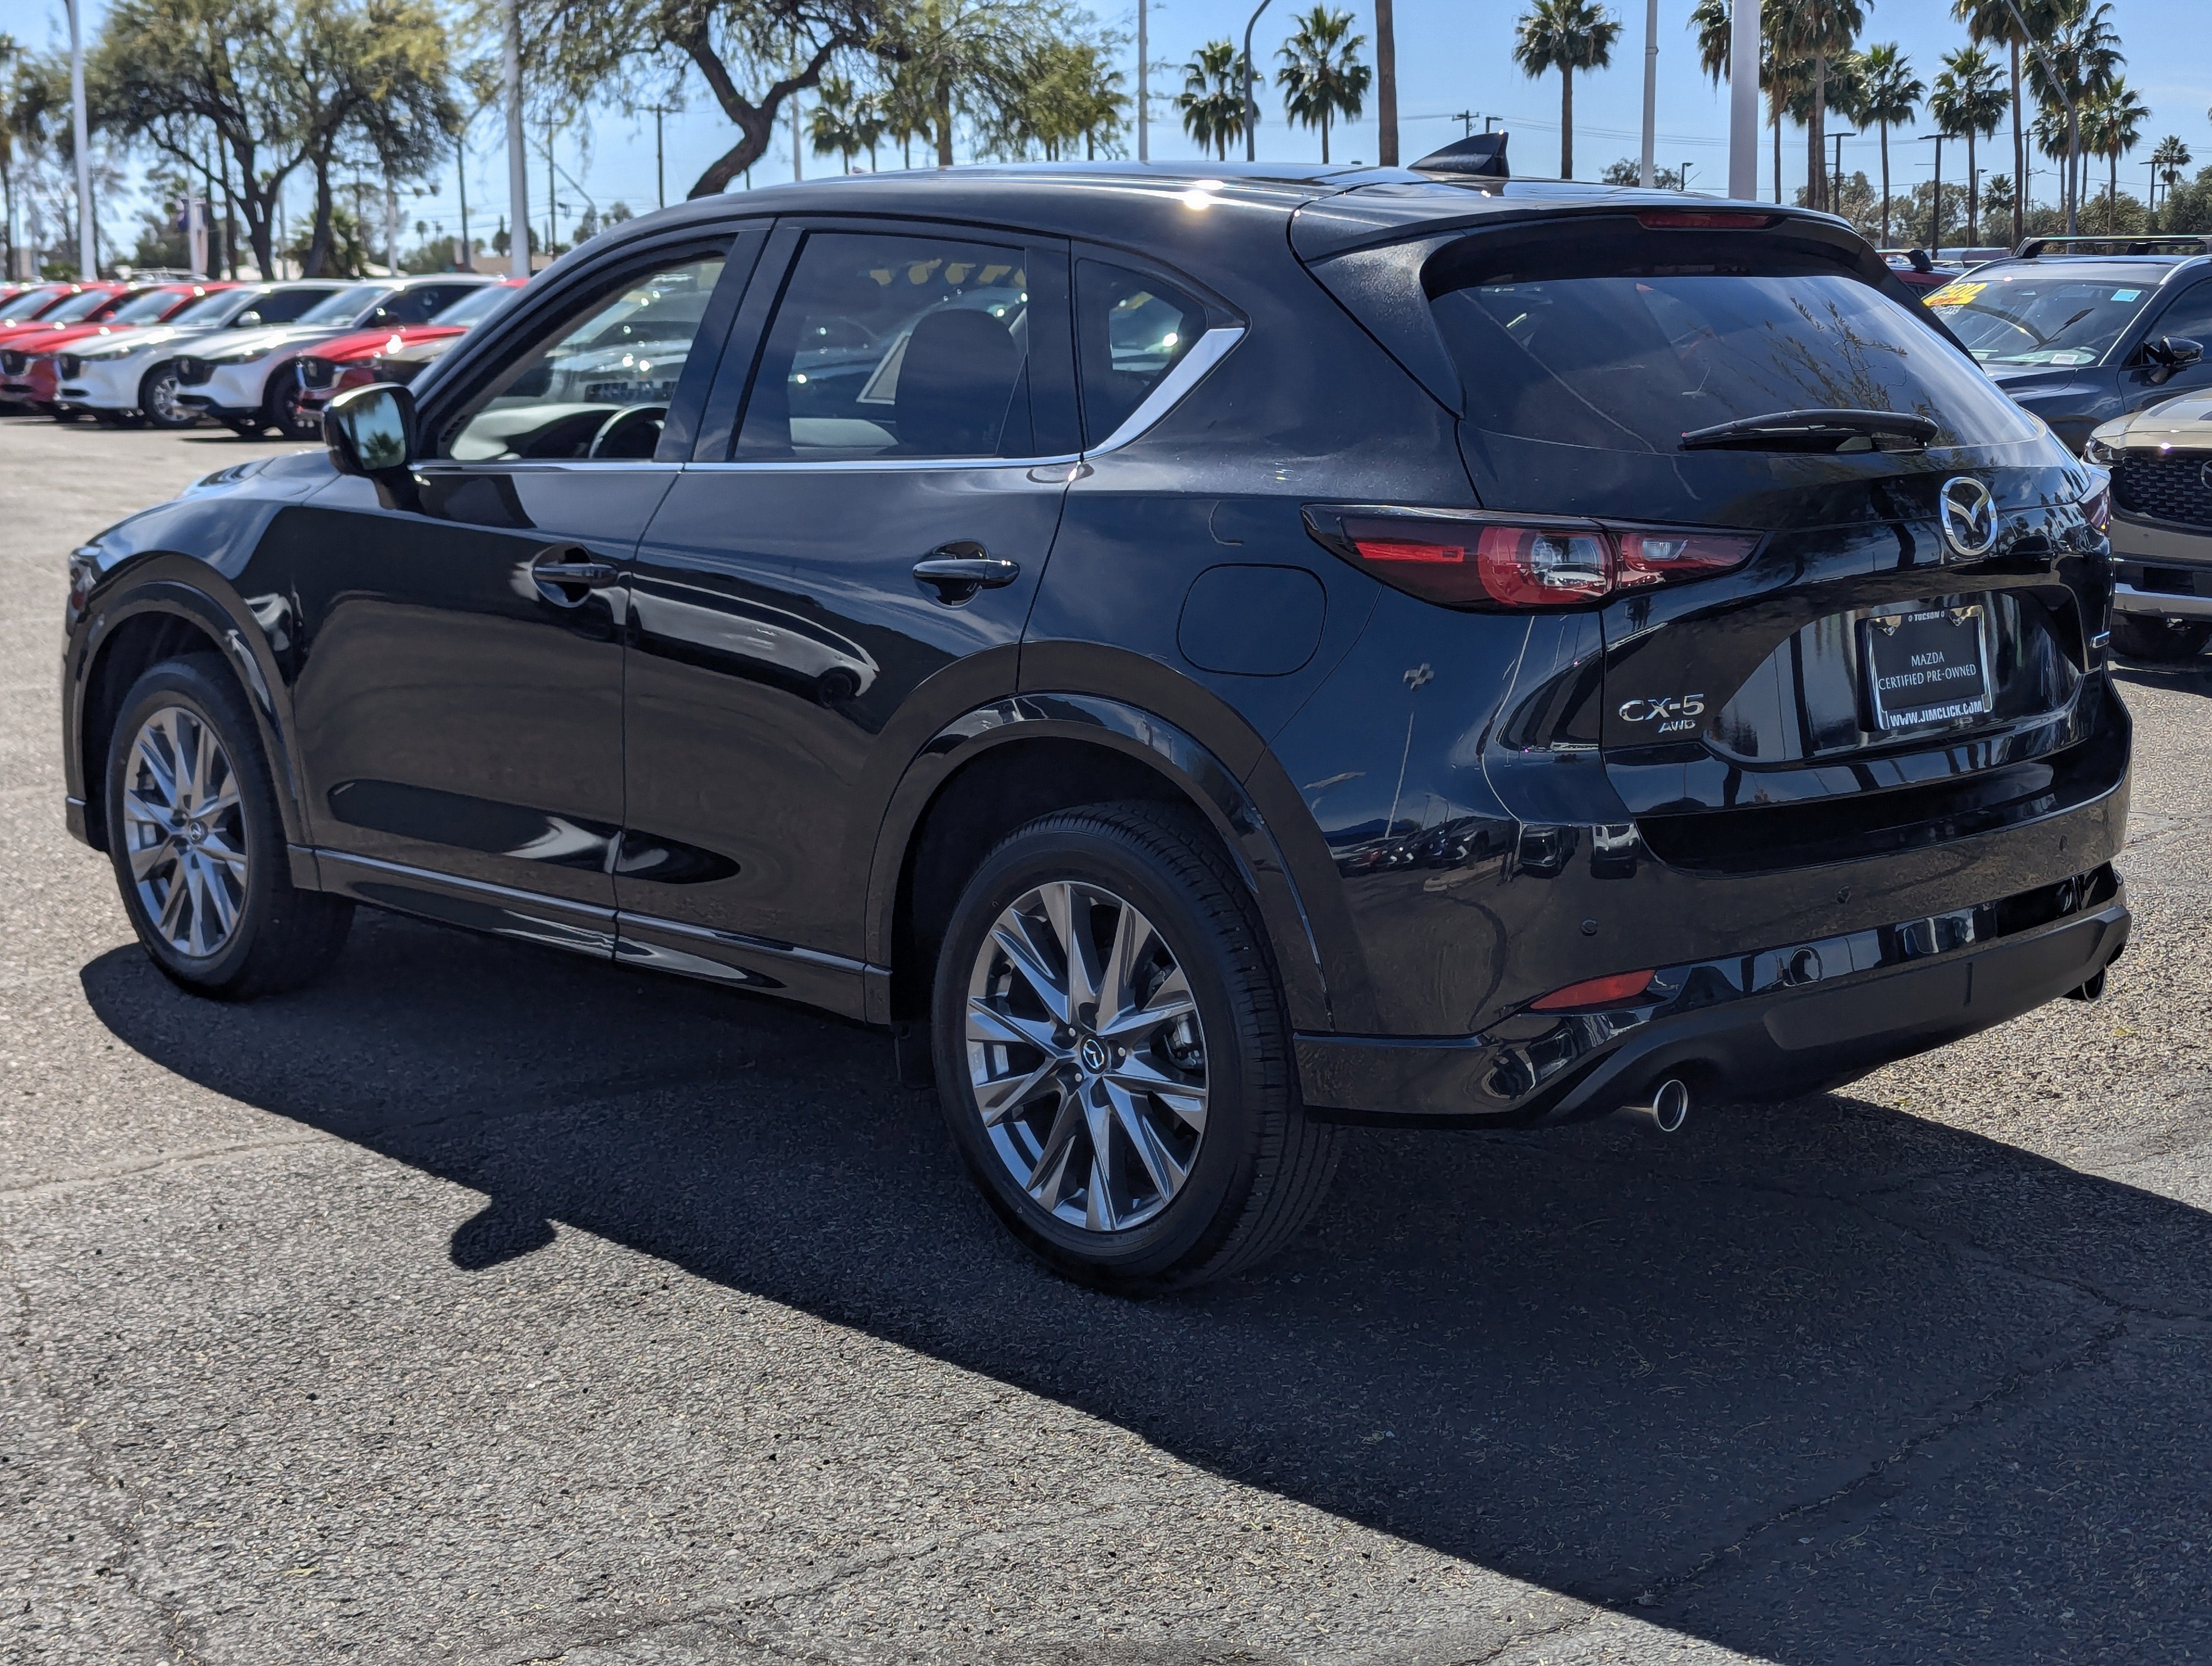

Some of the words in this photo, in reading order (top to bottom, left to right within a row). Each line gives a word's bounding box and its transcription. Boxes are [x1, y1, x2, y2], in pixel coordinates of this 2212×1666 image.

[1914, 611, 1940, 621] TUCSON
[1911, 651, 1945, 667] MAZDA
[1878, 672, 1924, 690] CERTIFIED
[1926, 664, 1977, 683] PRE-OWNED
[1619, 693, 1705, 722] CX-5
[1890, 700, 1983, 727] WWW.JIMCLICK.COM
[1658, 719, 1696, 733] AWD
